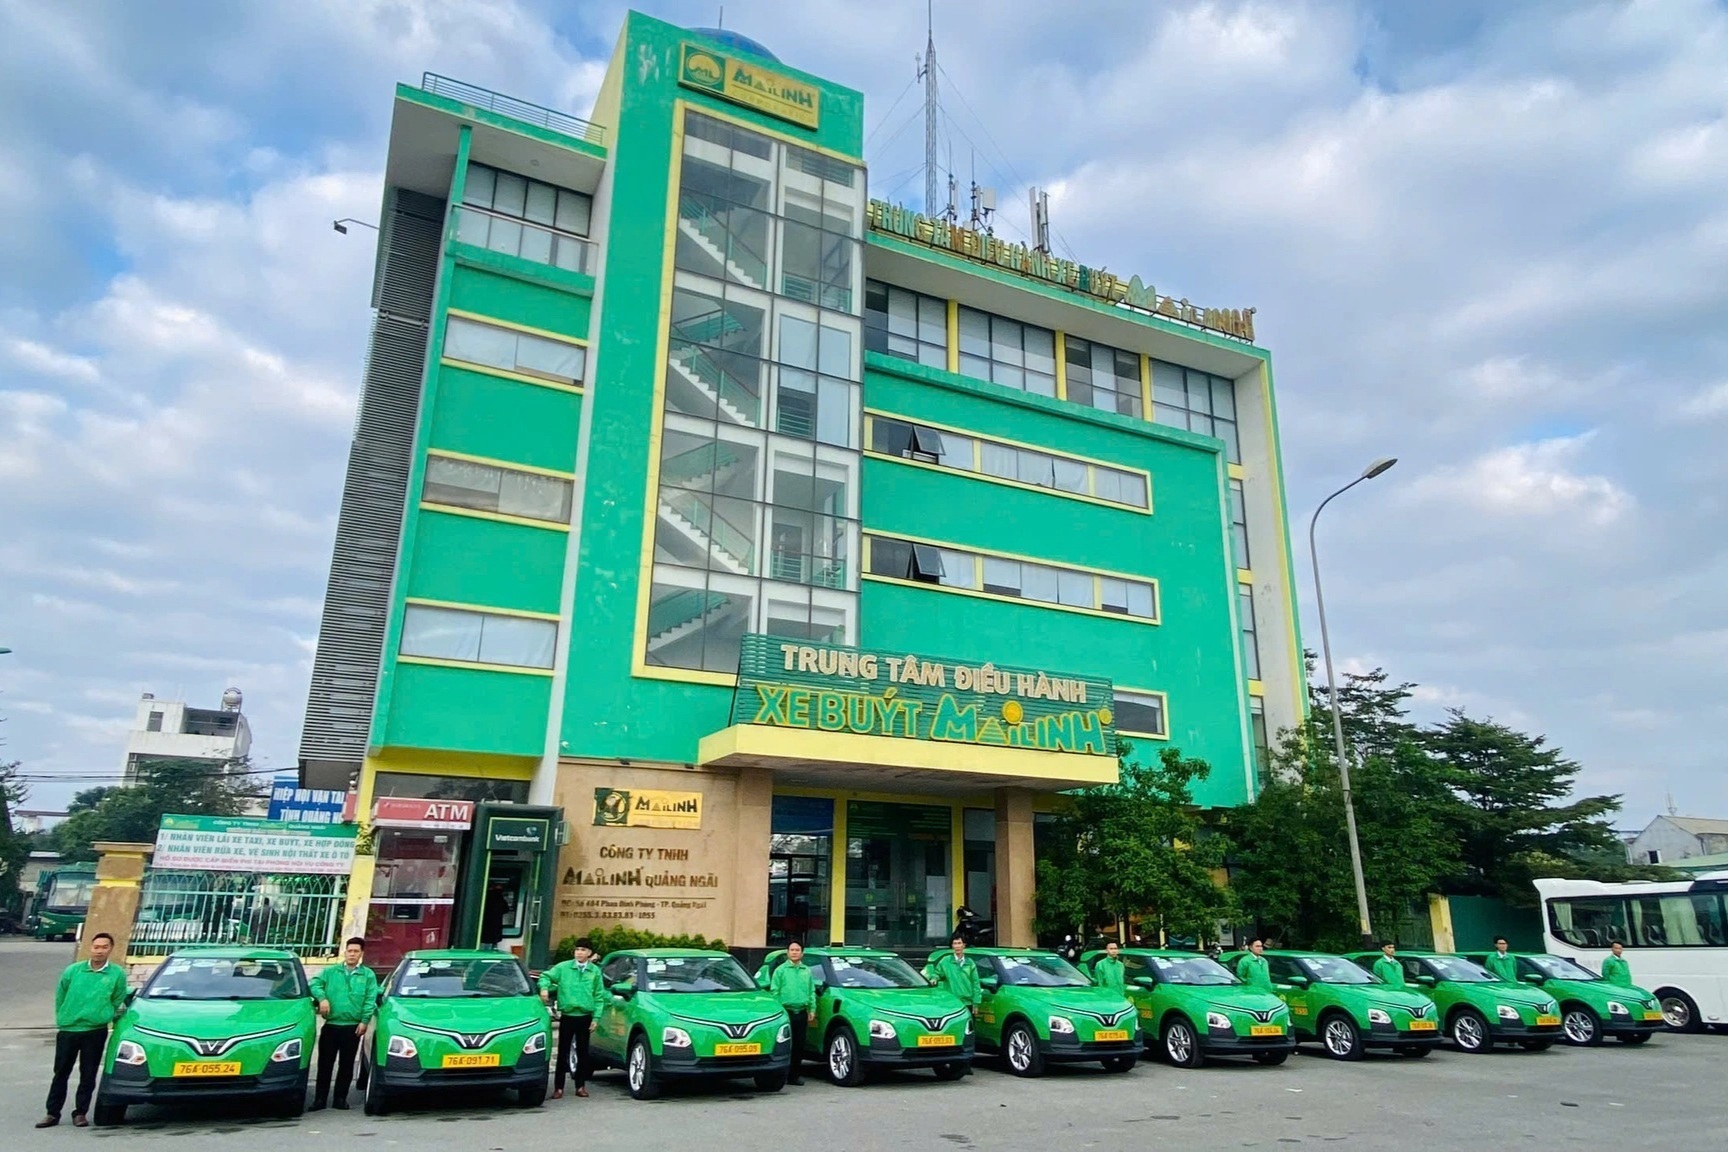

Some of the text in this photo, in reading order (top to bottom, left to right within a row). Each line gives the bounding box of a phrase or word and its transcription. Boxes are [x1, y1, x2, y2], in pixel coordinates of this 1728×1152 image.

[870, 198, 925, 240] TRUNG
[1009, 241, 1052, 280] HÀNH
[1055, 258, 1077, 287] XE
[780, 644, 1087, 704] TRUNG TÂM ĐIỀU HÀNH
[753, 684, 811, 729] XE
[818, 687, 923, 738] BUÝT
[424, 803, 469, 820] ATM
[495, 834, 540, 842] Vietcombank
[600, 844, 689, 861] CÔNG TY TNHH
[645, 871, 686, 888] QUẢNG
[689, 873, 718, 887] NGÃI
